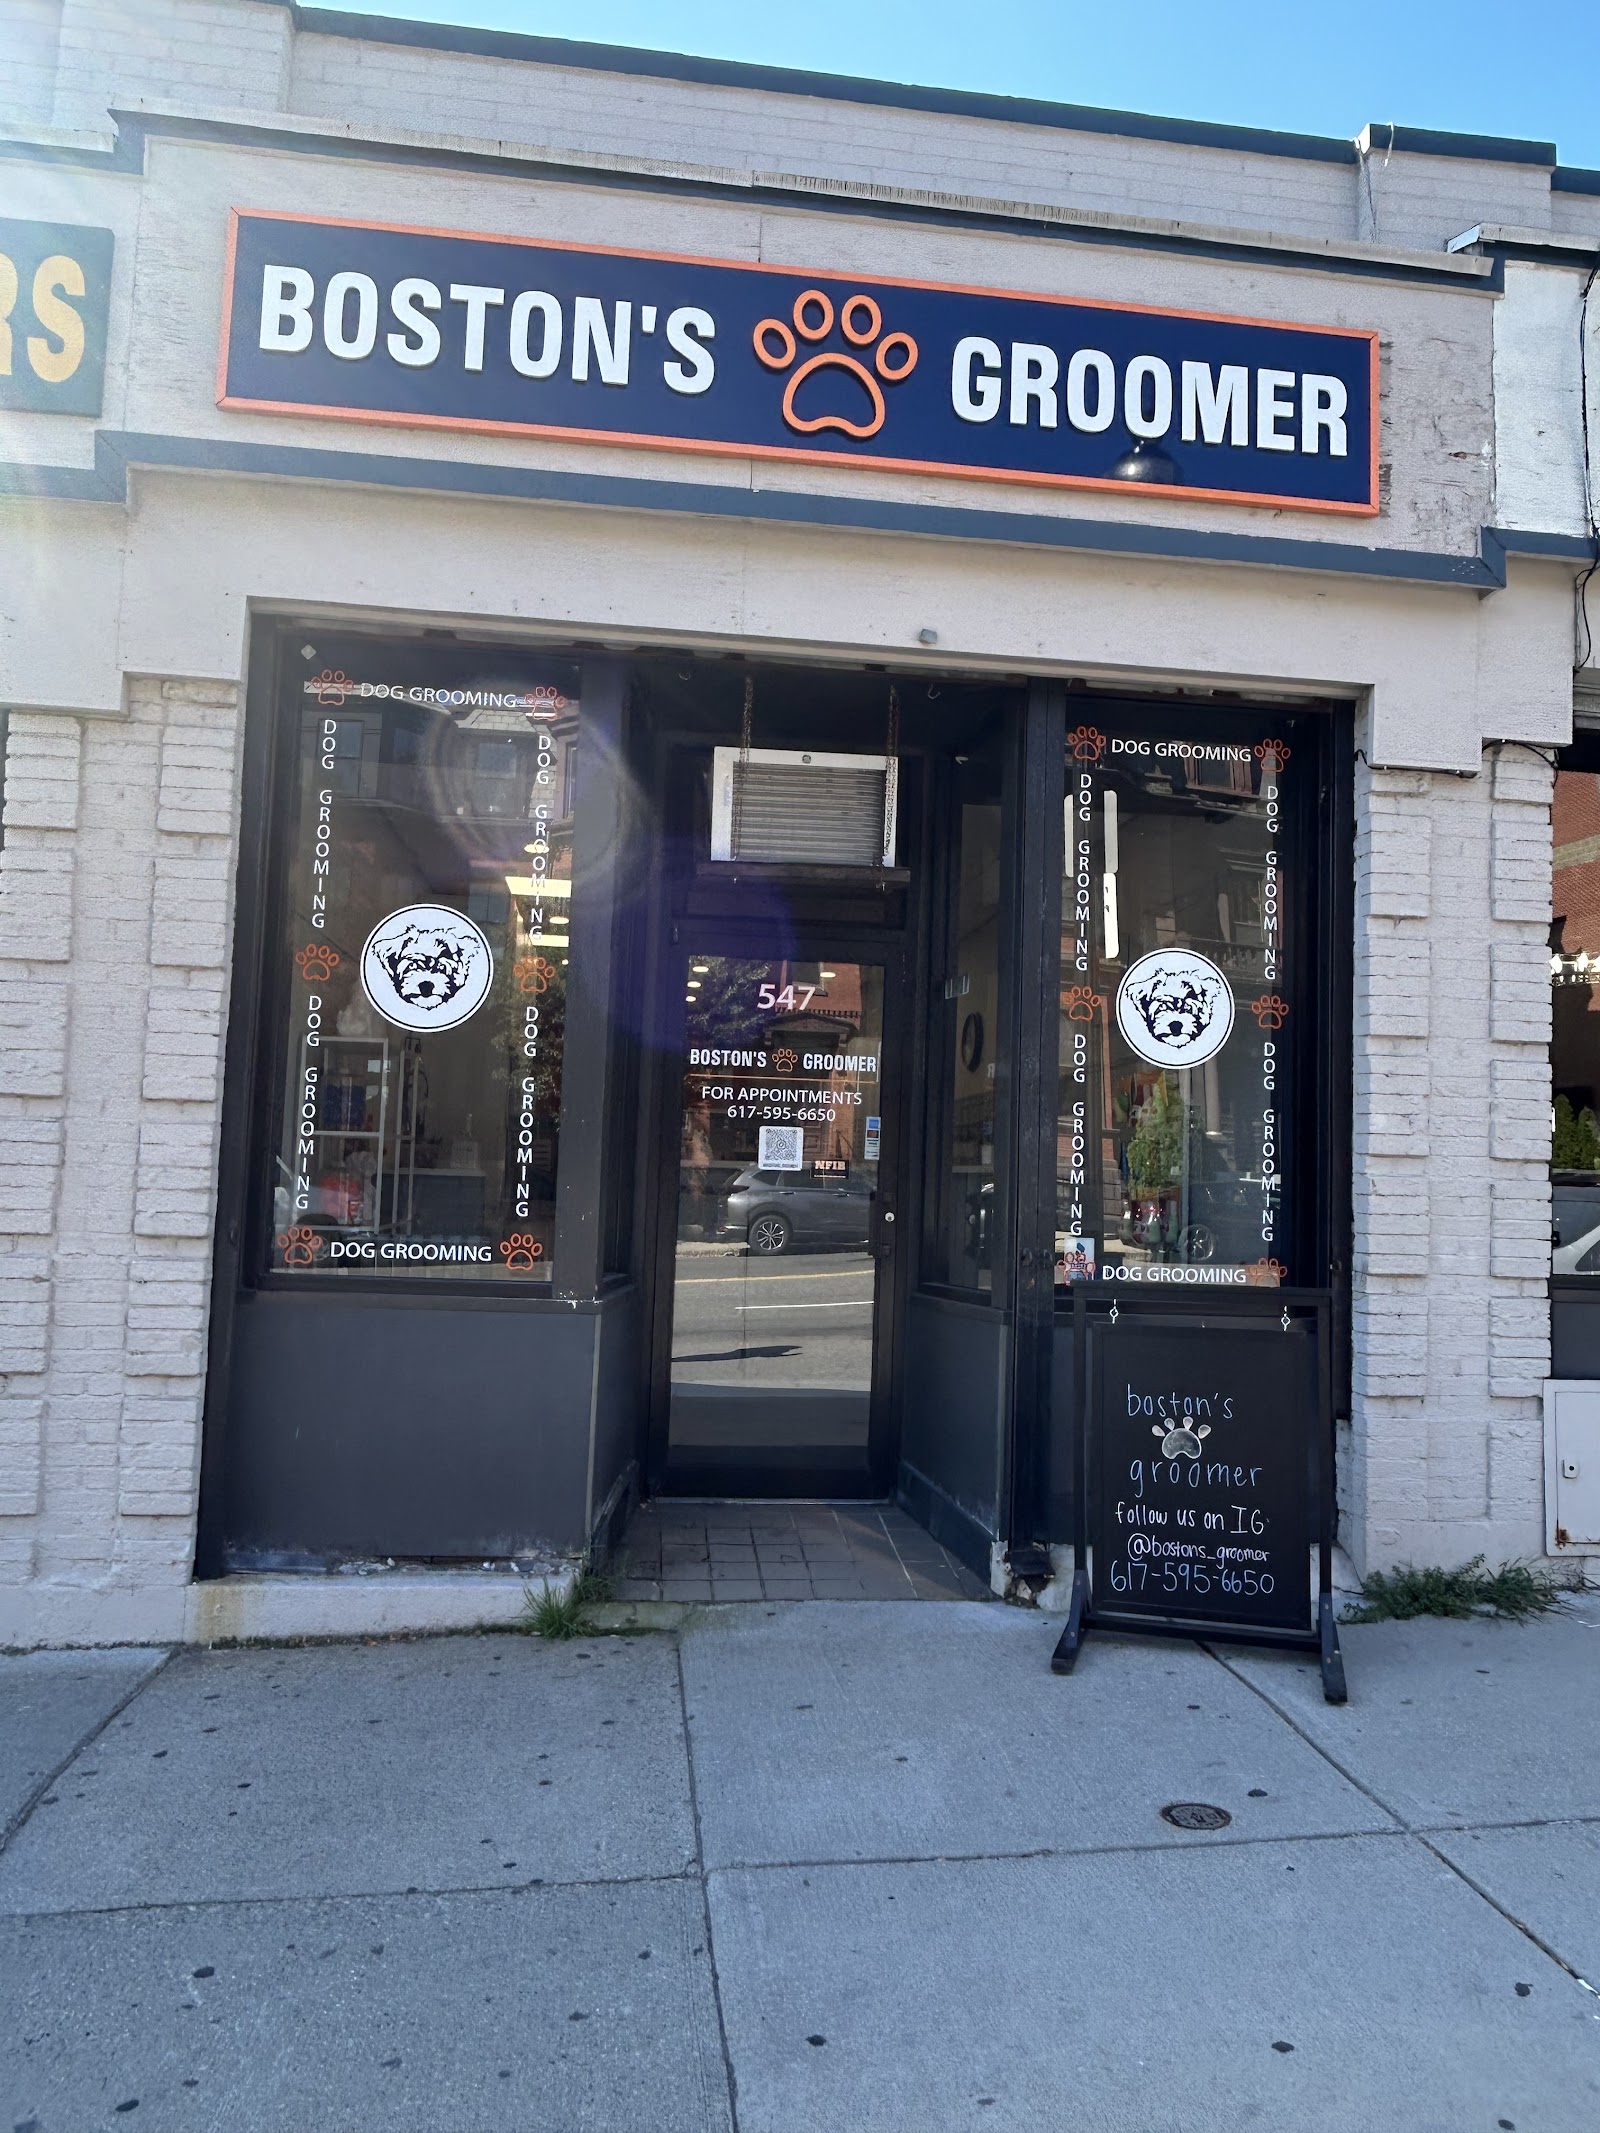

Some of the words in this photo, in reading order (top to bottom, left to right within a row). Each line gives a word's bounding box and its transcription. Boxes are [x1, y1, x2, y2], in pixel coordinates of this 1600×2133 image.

[259, 264, 715, 394] BOSTON'S
[951, 336, 1348, 457] GROOMER
[360, 682, 404, 699] DOG
[409, 687, 517, 708] GROOMING
[321, 719, 337, 770] DOG
[536, 735, 551, 785] DOG
[1111, 739, 1150, 755] DOG
[1155, 742, 1252, 762] GROOMING
[1080, 774, 1092, 821] DOG
[1266, 785, 1278, 833] DOG
[312, 789, 333, 928] GROOMING
[529, 804, 548, 940] GROOMING
[1075, 840, 1090, 971] GROOMING
[1263, 851, 1278, 980] GROOMING
[306, 995, 322, 1047] DOG
[757, 984, 816, 1011] 547
[523, 1006, 539, 1057] DOG
[689, 1048, 767, 1068] BOSTON'S
[803, 1053, 877, 1072] GROOMER
[1073, 1034, 1086, 1083] DOG
[1263, 1042, 1276, 1090] DOG
[702, 1086, 734, 1101] FOR
[738, 1088, 862, 1105] APPOINTMENTS
[727, 1105, 836, 1122] 617-595-6650
[295, 1066, 318, 1209] GROOMING
[515, 1077, 535, 1217] GROOMING
[1070, 1102, 1084, 1236] GROOMING
[1261, 1109, 1275, 1241] GROOMING
[330, 1241, 376, 1259] DOG
[380, 1243, 492, 1262] GROOMING
[1102, 1265, 1142, 1281] DOG
[1146, 1267, 1247, 1283] GROOMING
[1127, 1384, 1234, 1419] boston's
[1130, 1459, 1263, 1498] groomer
[1115, 1501, 1168, 1526] follow
[1177, 1508, 1196, 1527] us
[1204, 1511, 1225, 1530] on
[1230, 1505, 1265, 1535] IG
[1128, 1533, 1271, 1569] @bostons_groomer
[1110, 1560, 1275, 1595] 617-595-6650
